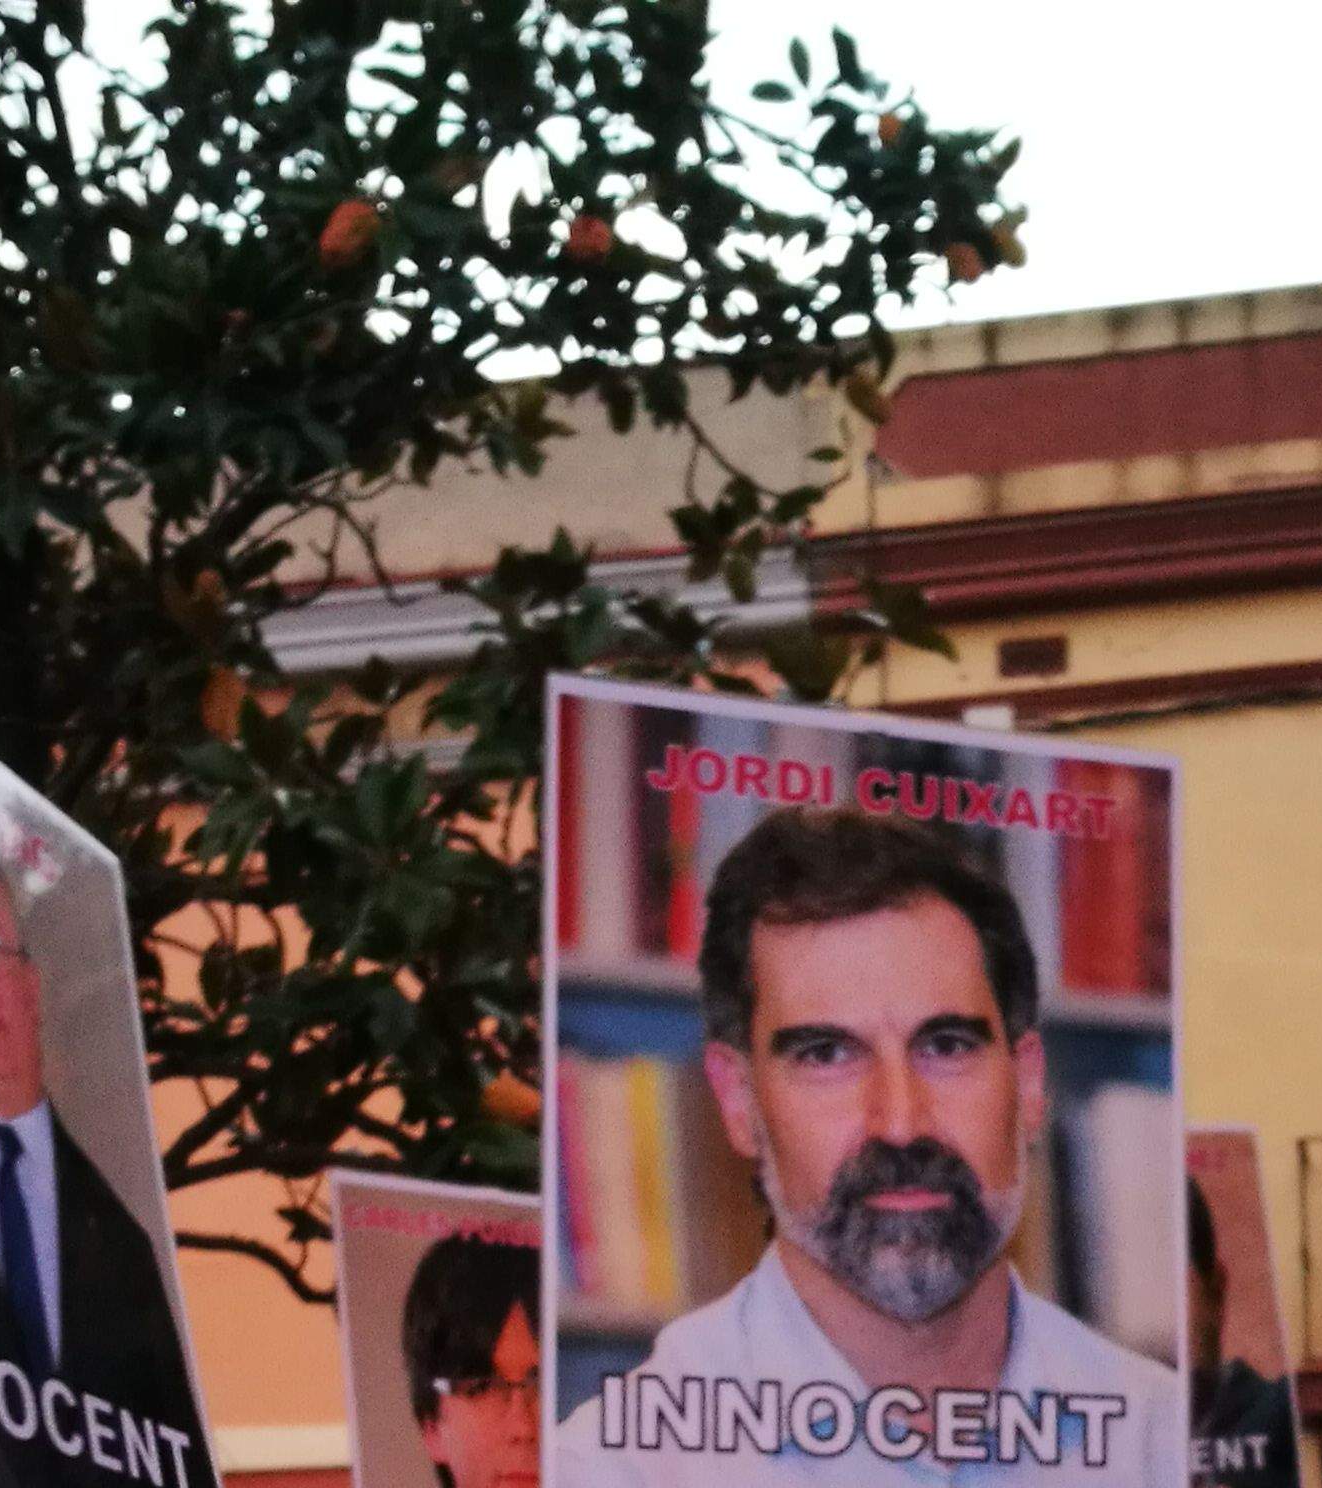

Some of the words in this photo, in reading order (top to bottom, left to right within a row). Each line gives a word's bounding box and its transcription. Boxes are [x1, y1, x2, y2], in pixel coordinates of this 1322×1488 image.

[647, 744, 834, 804] JORDI
[857, 767, 1119, 839] CUIXART
[600, 1374, 1127, 1467] INNOCENT
